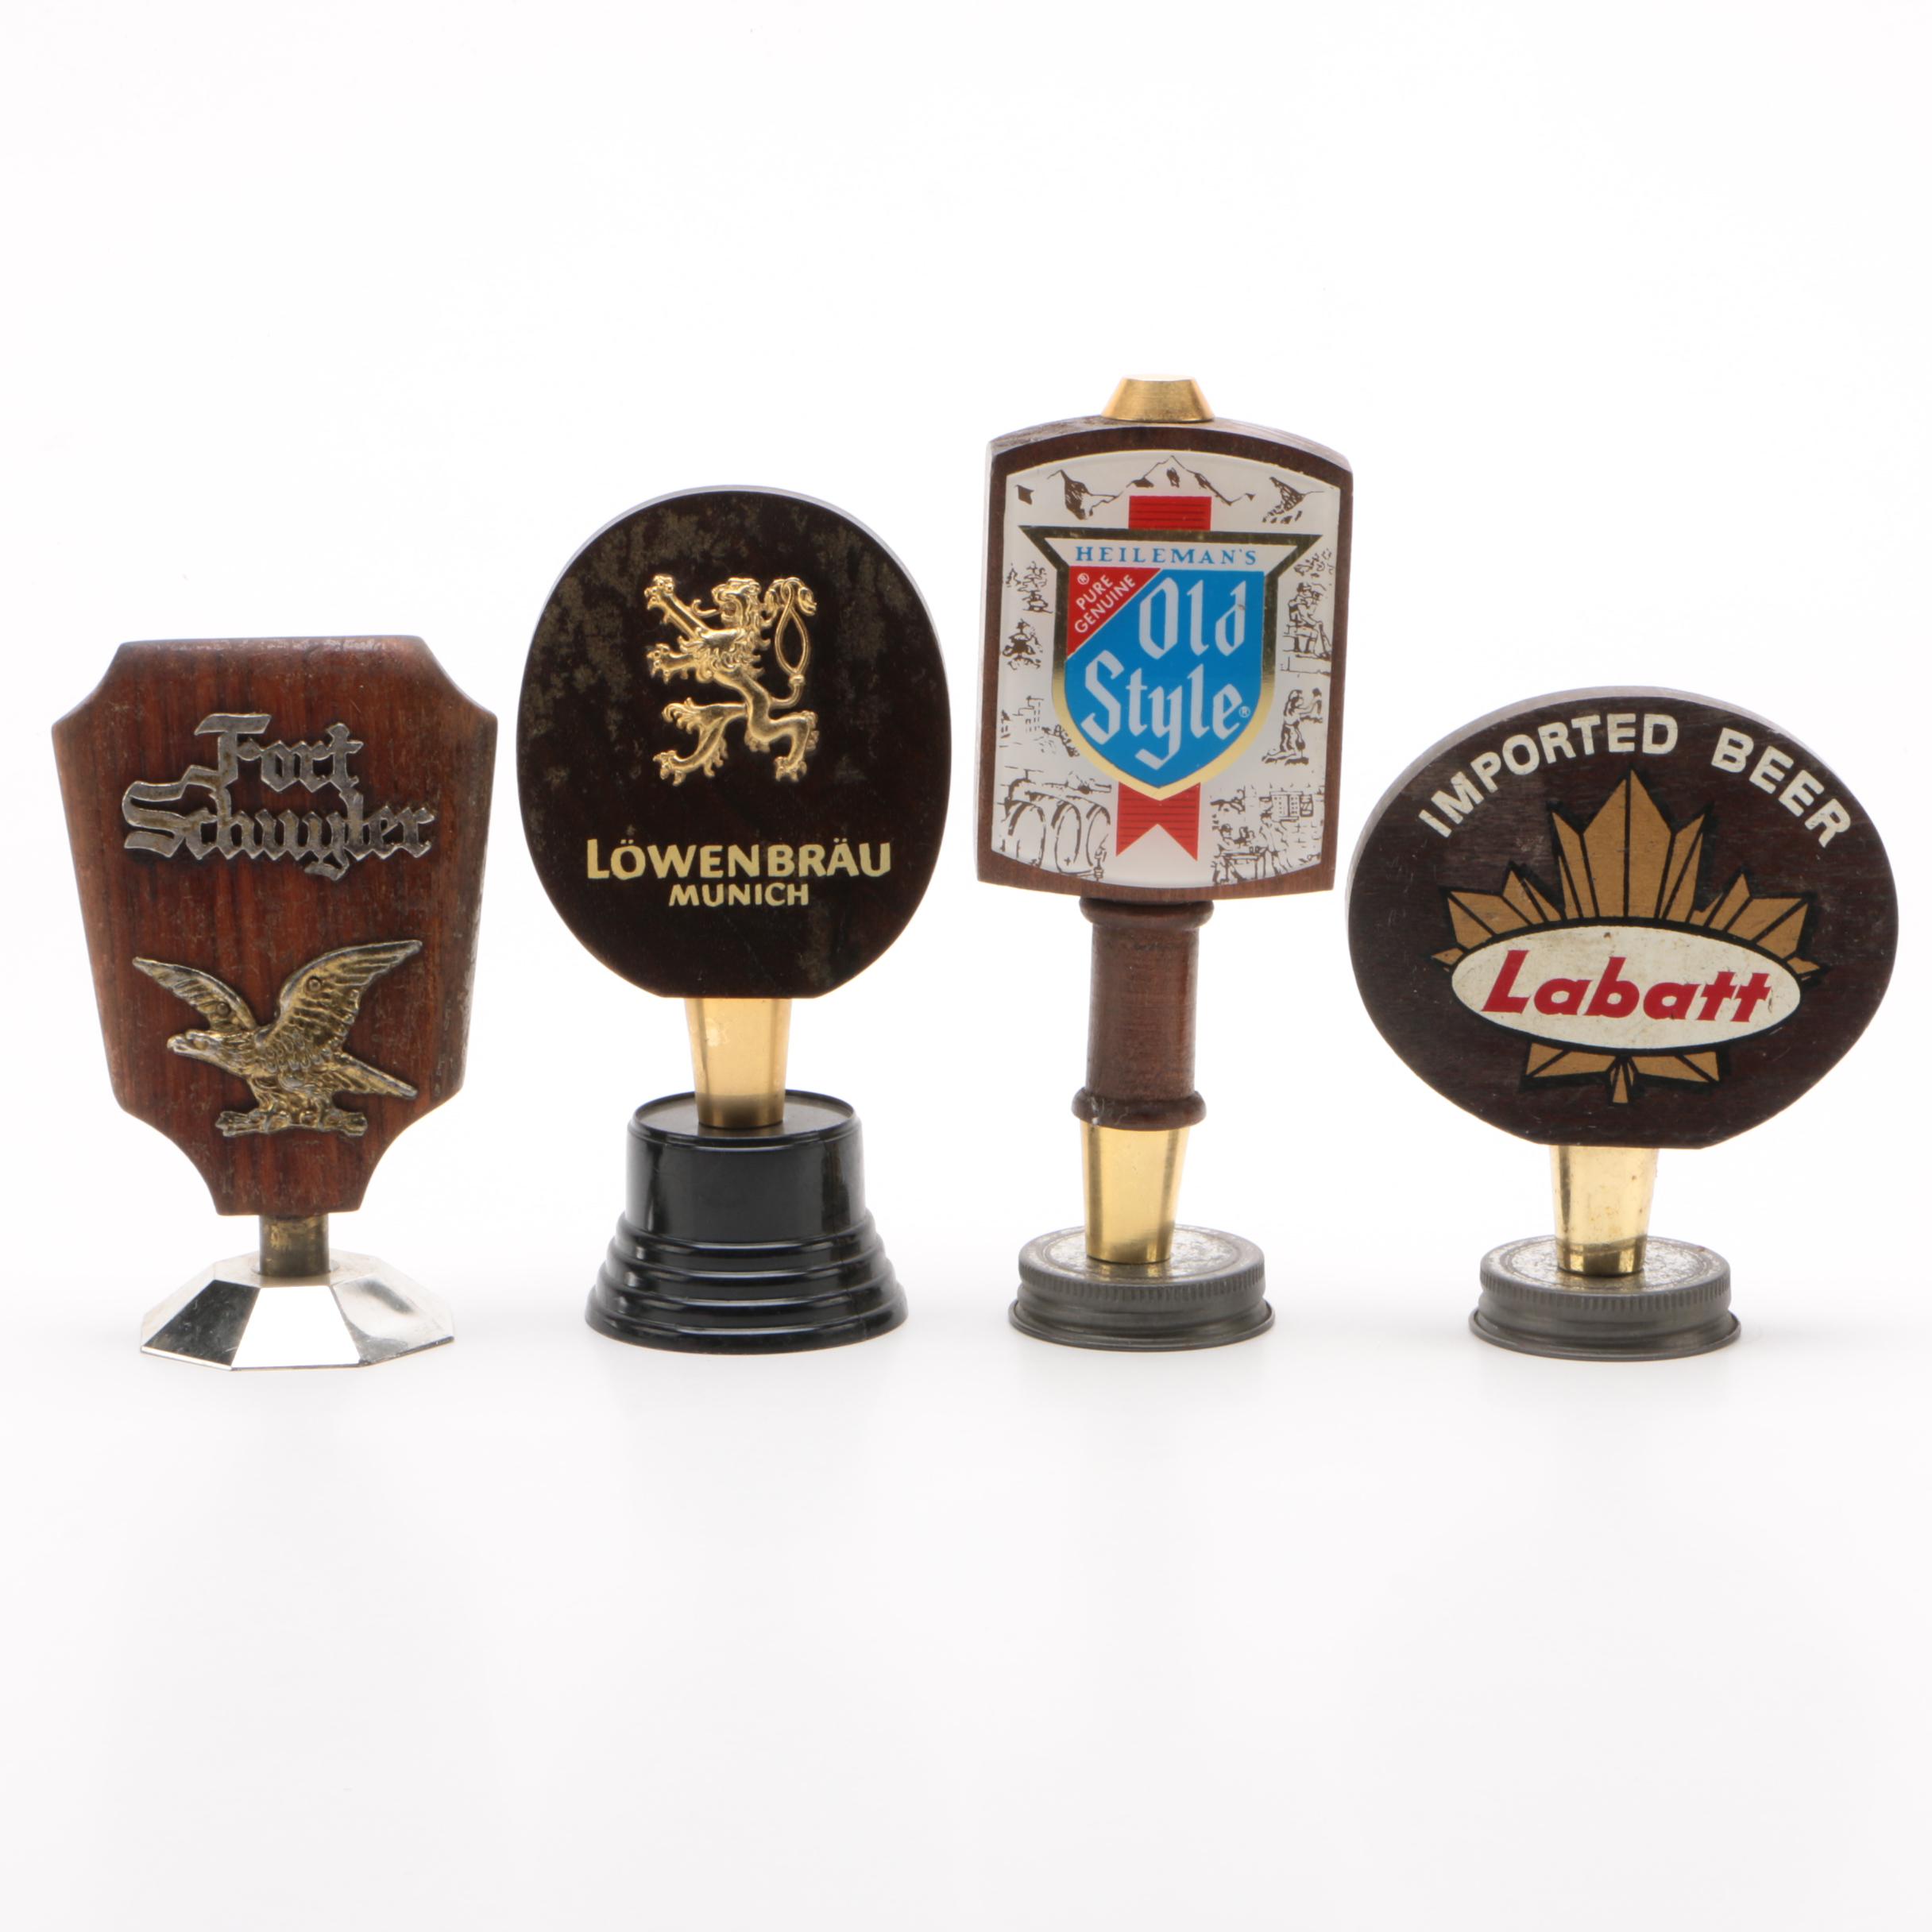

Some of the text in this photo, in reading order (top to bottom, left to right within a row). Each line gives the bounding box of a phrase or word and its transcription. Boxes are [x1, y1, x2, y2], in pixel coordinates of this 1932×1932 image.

[1075, 544, 1257, 565] HEILEMAN'S
[1074, 574, 1137, 635] GENUINE
[1076, 573, 1114, 610] PURE
[1138, 576, 1246, 660] Old
[195, 712, 365, 794] Fort
[1418, 713, 1852, 848] IMPORTED BEER
[122, 764, 436, 881] Schuyler
[586, 837, 891, 880] LÖWENBRÄU
[668, 882, 810, 907] MUNICH
[1480, 949, 1772, 1023] Labatt
